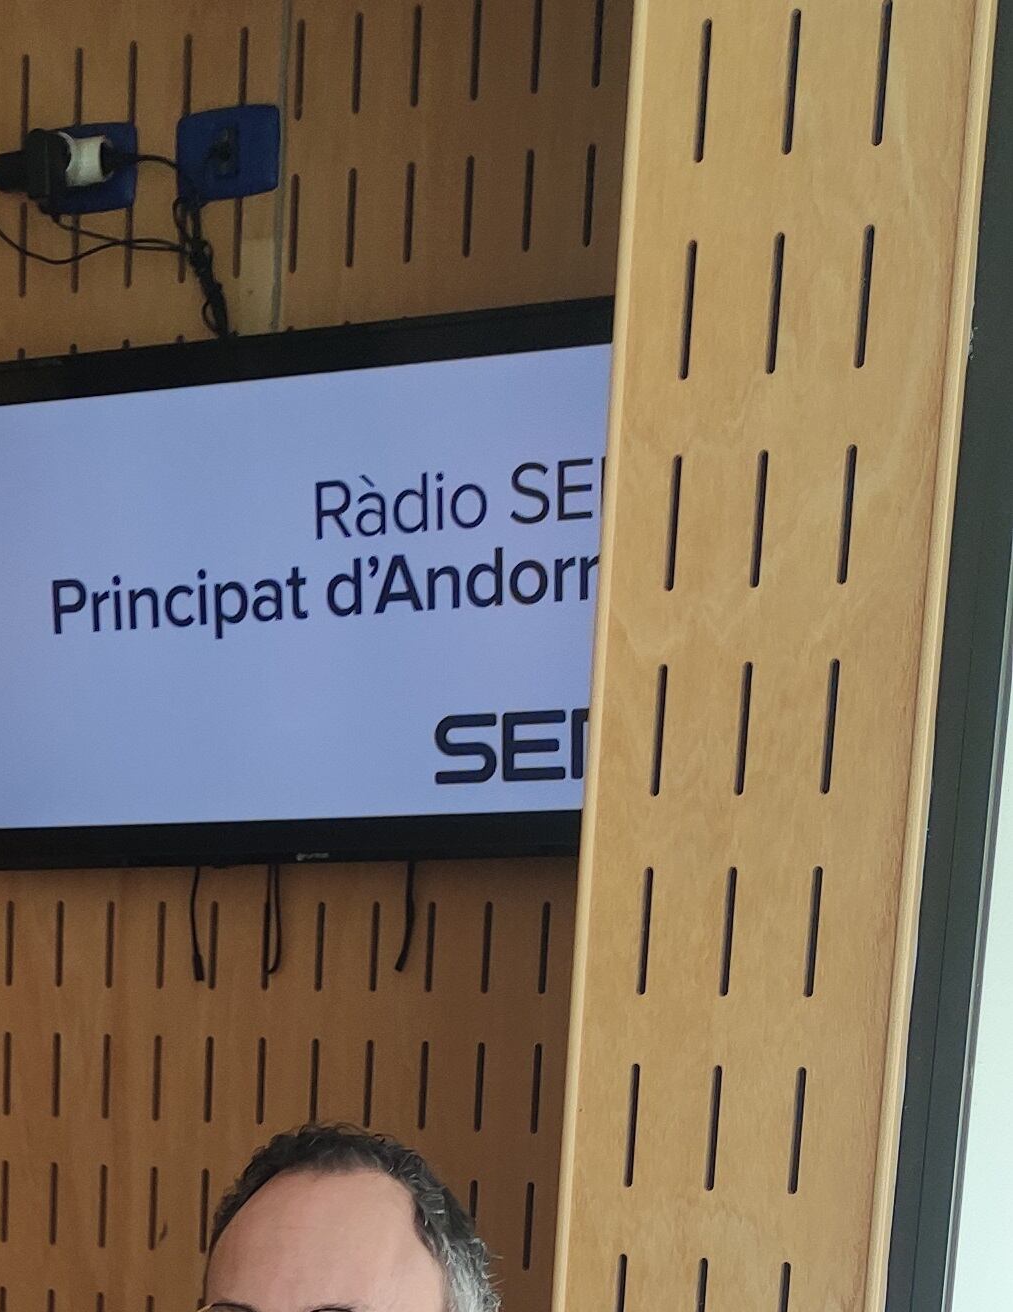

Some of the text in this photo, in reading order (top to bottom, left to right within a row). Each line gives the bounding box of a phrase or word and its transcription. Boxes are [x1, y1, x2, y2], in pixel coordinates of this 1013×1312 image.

[314, 456, 606, 540] Ràdio SE
[51, 566, 308, 639] Principat
